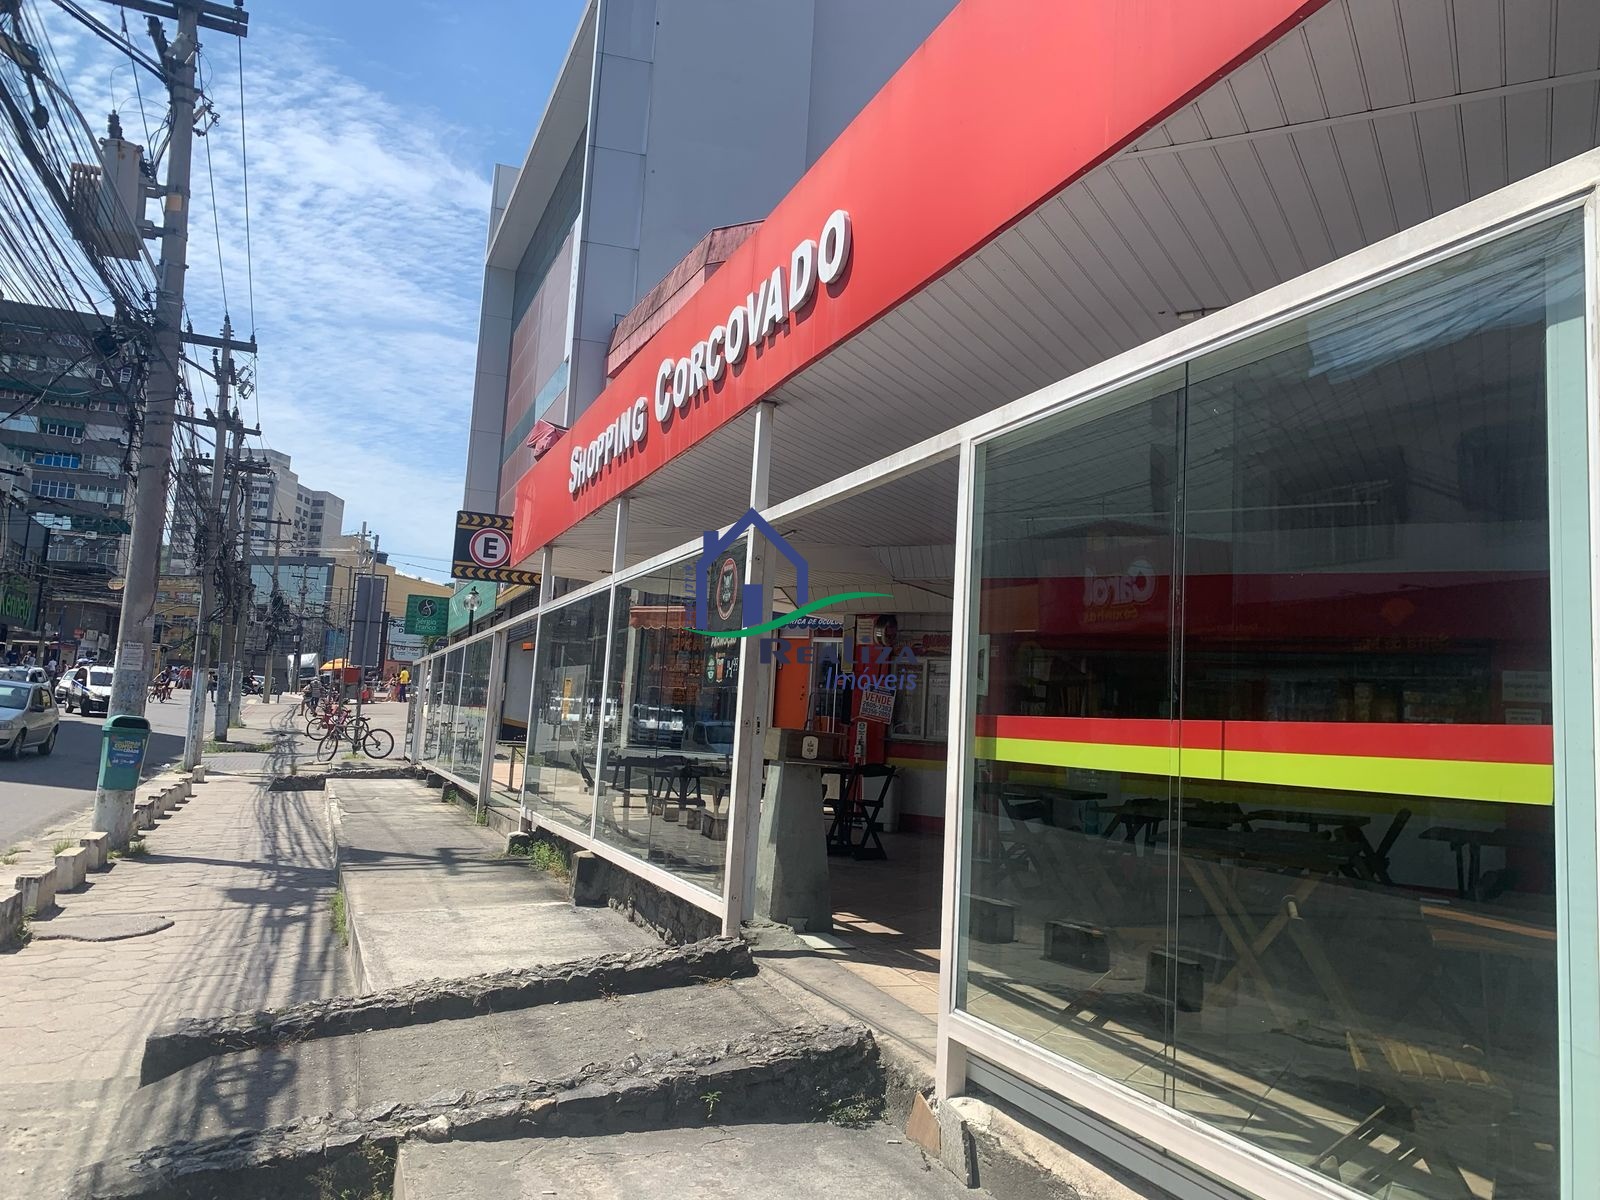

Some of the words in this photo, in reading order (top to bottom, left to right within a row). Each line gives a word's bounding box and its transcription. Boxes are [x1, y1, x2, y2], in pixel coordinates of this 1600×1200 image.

[568, 396, 648, 493] SHOPPING
[655, 209, 851, 422] CORCOVADO
[483, 537, 498, 558] E
[865, 692, 892, 705] VENDE
